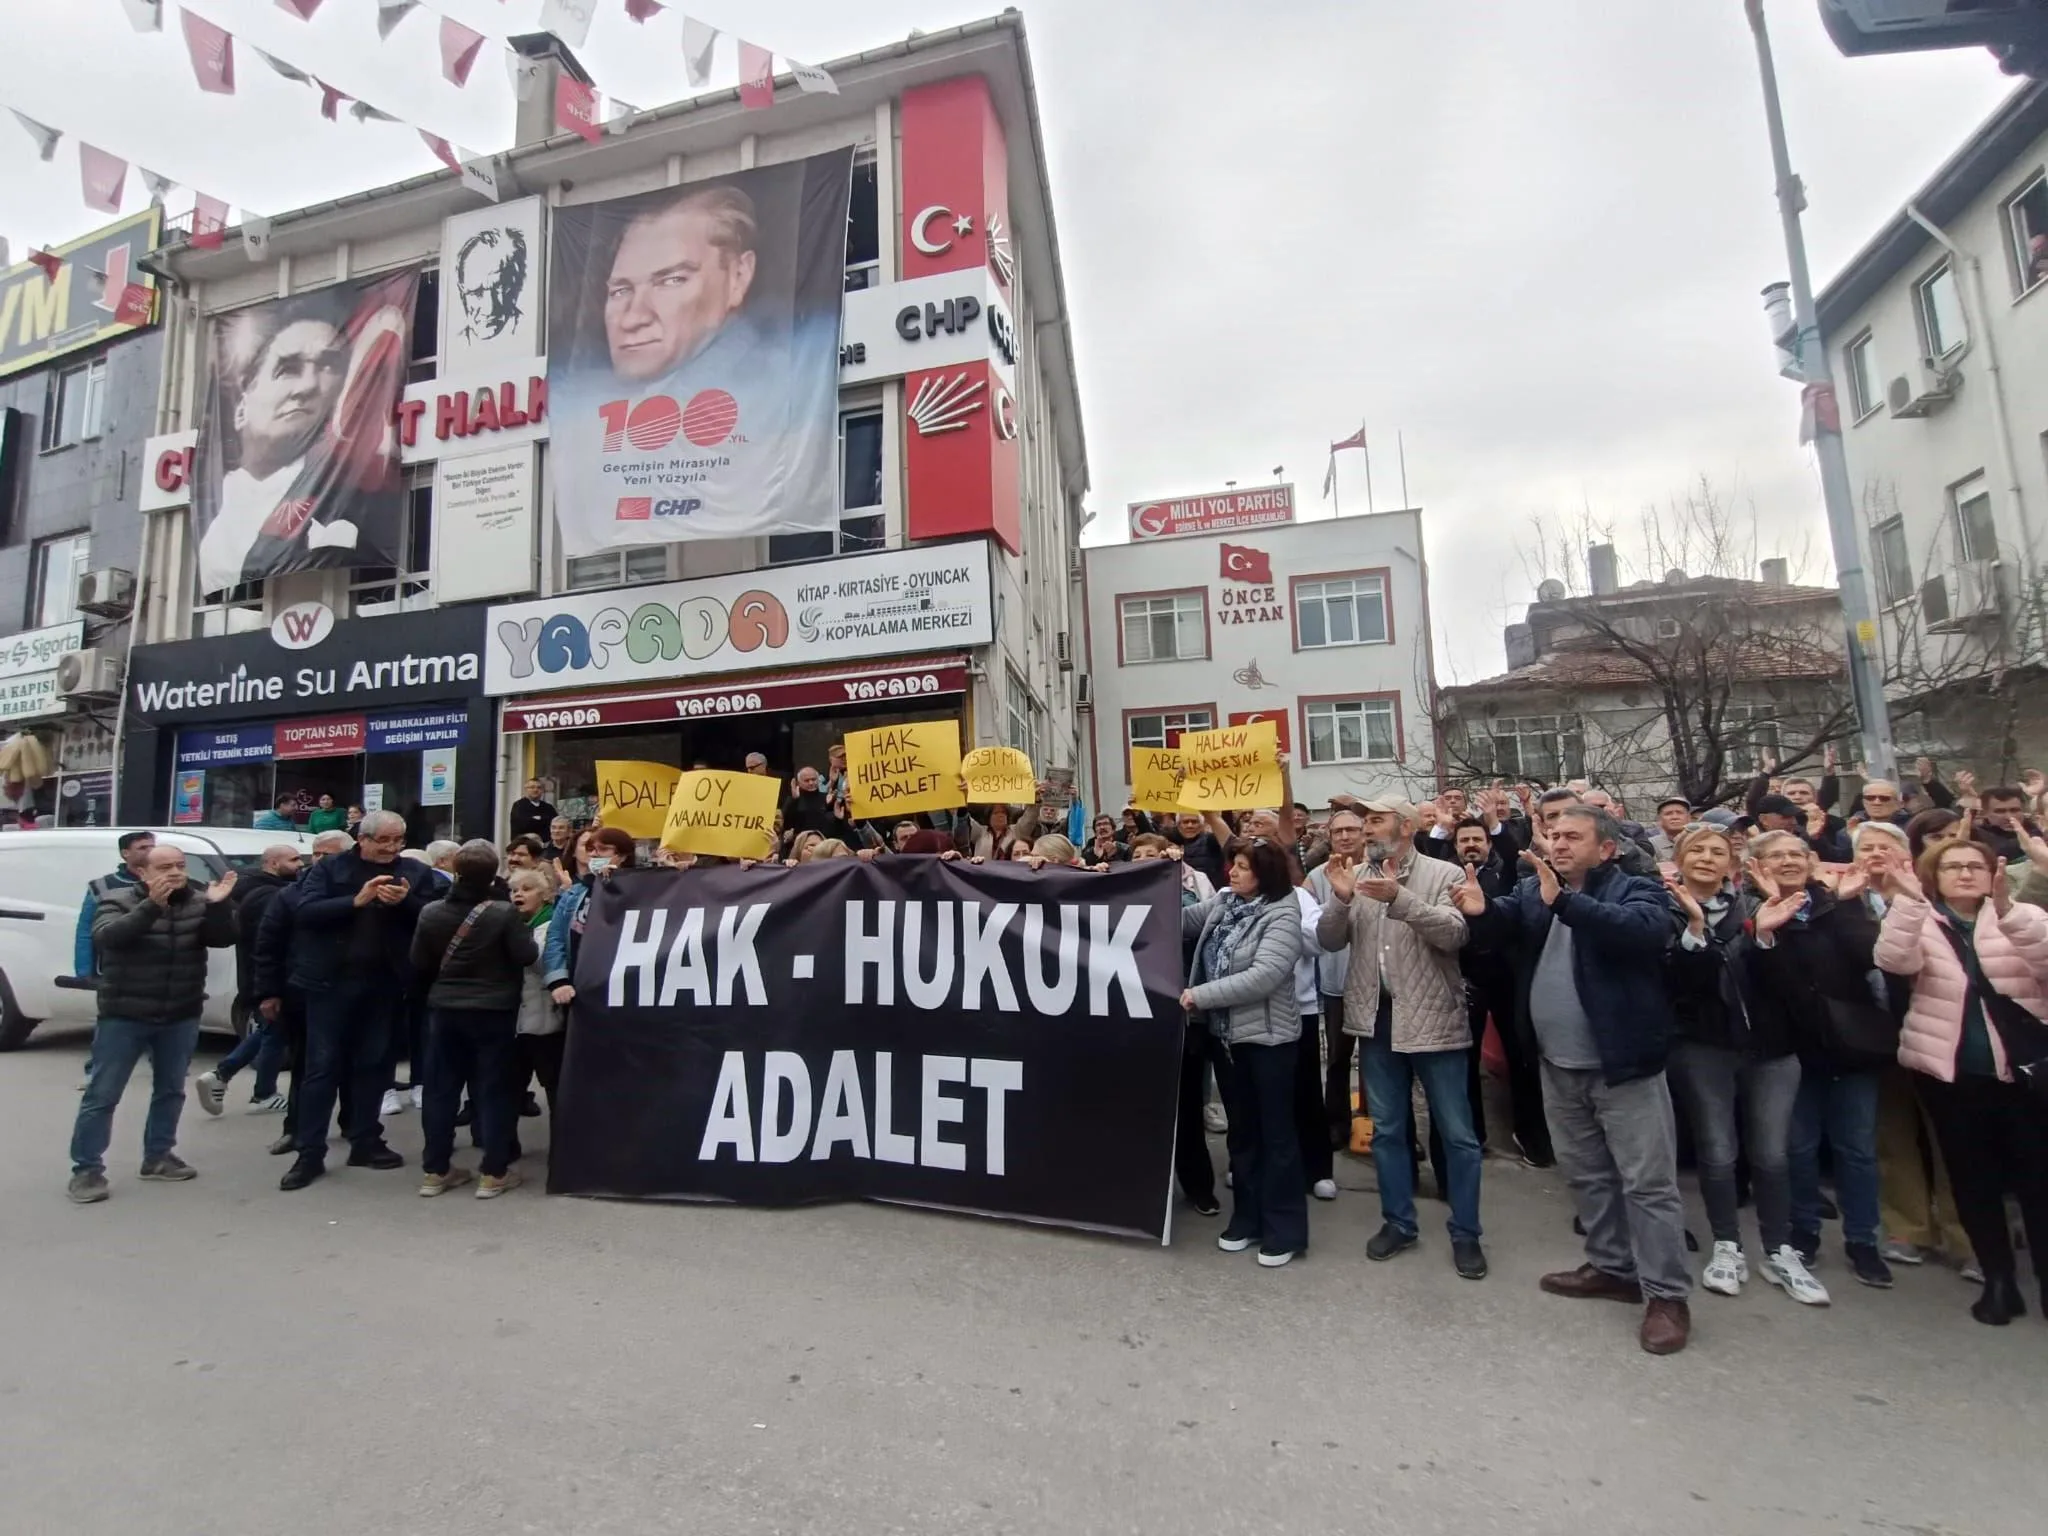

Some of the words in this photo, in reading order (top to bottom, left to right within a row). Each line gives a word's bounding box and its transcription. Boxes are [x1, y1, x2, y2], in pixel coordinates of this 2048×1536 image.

[896, 296, 980, 340] CHP
[598, 388, 738, 453] 100
[602, 461, 664, 474] Geçmişin
[670, 456, 730, 471] Mirasıyla
[624, 474, 652, 485] Yeni
[658, 472, 707, 484] Yüzyıla
[654, 499, 701, 516] CHP
[1170, 497, 1204, 520] MİLLİ
[1208, 498, 1234, 515] YOL
[1237, 488, 1289, 512] PARTİSİ
[798, 584, 830, 603] KİTAP
[1222, 586, 1276, 606] ÖNCE
[826, 620, 908, 641] KOPYALAMA
[912, 609, 972, 632] MERKEZİ
[1217, 605, 1284, 626] VATAN
[498, 589, 790, 679] YAPADA
[32, 632, 80, 662] Sigorta
[11, 680, 56, 700] KAPISI
[137, 665, 283, 713] Waterline
[296, 668, 336, 698] Su
[346, 652, 479, 693] Arıtma
[844, 674, 940, 700] YAPADA
[676, 693, 762, 717] YAPADA
[370, 720, 388, 731] TÜM
[390, 715, 444, 730] MARKALARIN
[524, 708, 600, 730] YAPADA
[216, 733, 239, 745] SATIŞ
[284, 727, 327, 742] TOPTAN
[328, 723, 359, 738] SATIŞ
[386, 730, 423, 745] DEĞİŞİMİ
[425, 729, 458, 740] YAPILIR
[870, 728, 921, 754] HAK
[1196, 732, 1248, 753] HALKIN
[180, 748, 211, 762] YETKİLİ
[212, 746, 242, 760] TEKNİK
[244, 744, 273, 757] SERVİS
[858, 756, 927, 784] HUKUK
[694, 777, 732, 808] OY
[868, 773, 942, 802] ADALET
[1198, 774, 1262, 799] SAYGI
[670, 811, 766, 832] NAMUSTUR
[608, 902, 773, 1008] HAK
[844, 899, 1155, 1019] HUKUK
[698, 1049, 1024, 1177] ADALET
